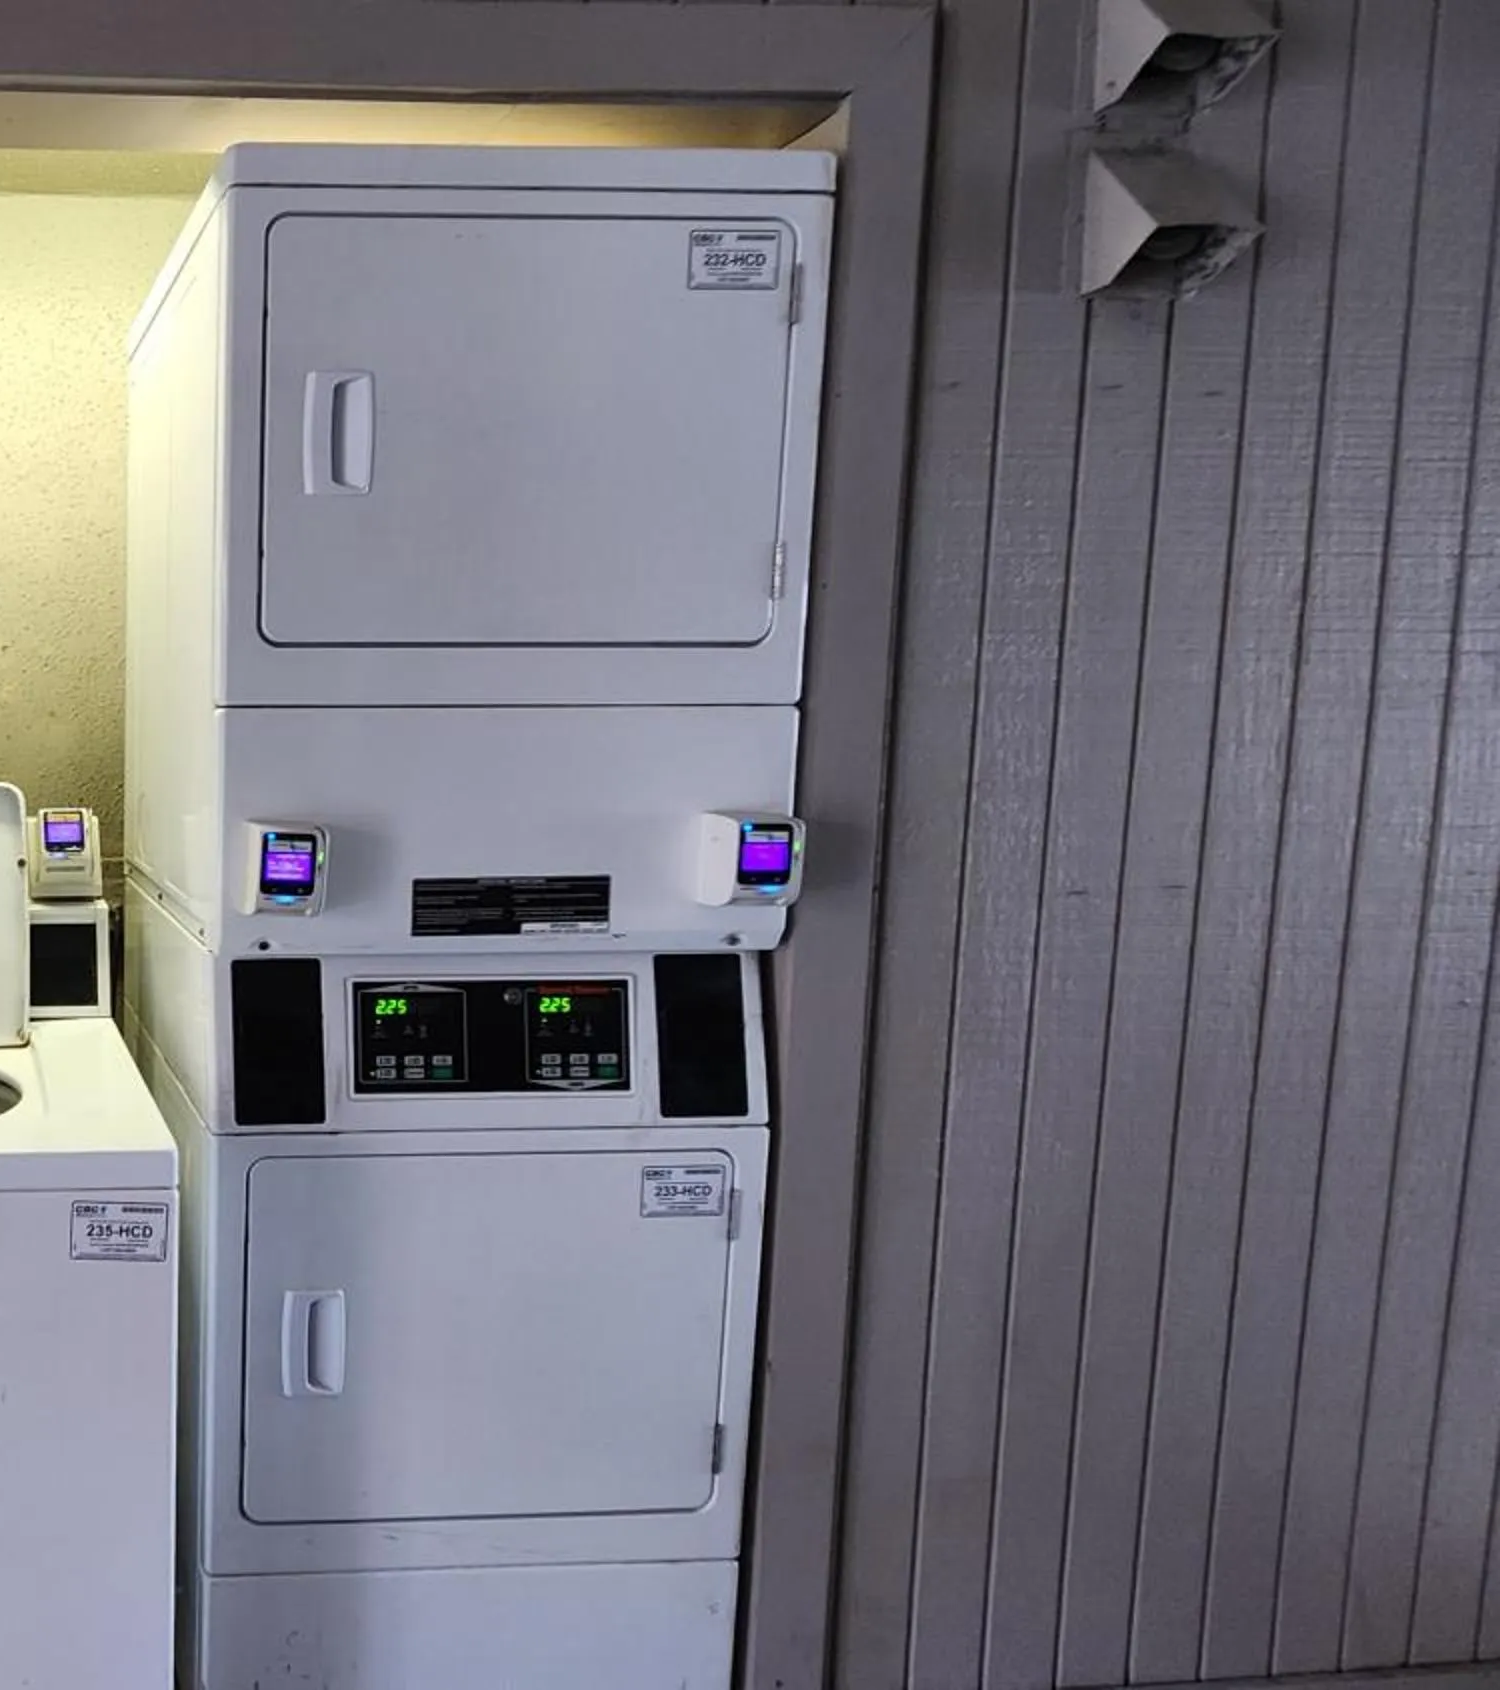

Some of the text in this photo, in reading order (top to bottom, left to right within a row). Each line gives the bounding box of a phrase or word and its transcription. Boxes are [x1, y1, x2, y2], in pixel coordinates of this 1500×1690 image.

[703, 253, 767, 266] 232-HCD
[654, 1185, 713, 1197] 233-HCD
[86, 1223, 153, 1239] 235-HCD
